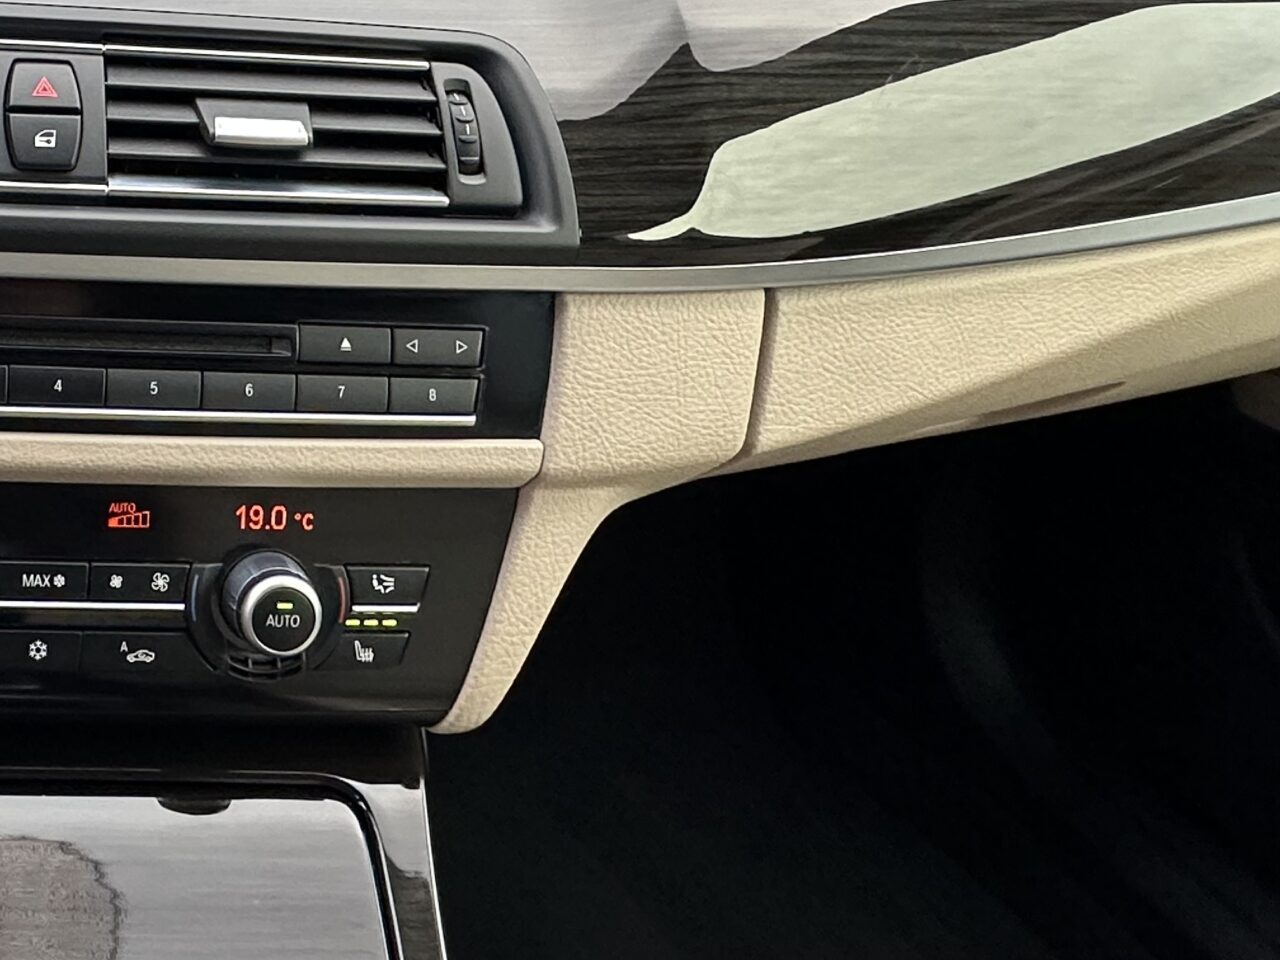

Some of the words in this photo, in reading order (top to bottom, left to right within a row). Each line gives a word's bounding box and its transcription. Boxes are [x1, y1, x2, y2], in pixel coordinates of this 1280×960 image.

[53, 379, 63, 392] 4
[150, 381, 159, 395] 5
[245, 383, 254, 397] 6
[337, 385, 346, 399] 7
[428, 388, 437, 402] 8
[108, 502, 136, 513] AUTO
[235, 505, 287, 530] 19.0
[22, 573, 51, 588] MAX
[265, 612, 301, 629] AUTO
